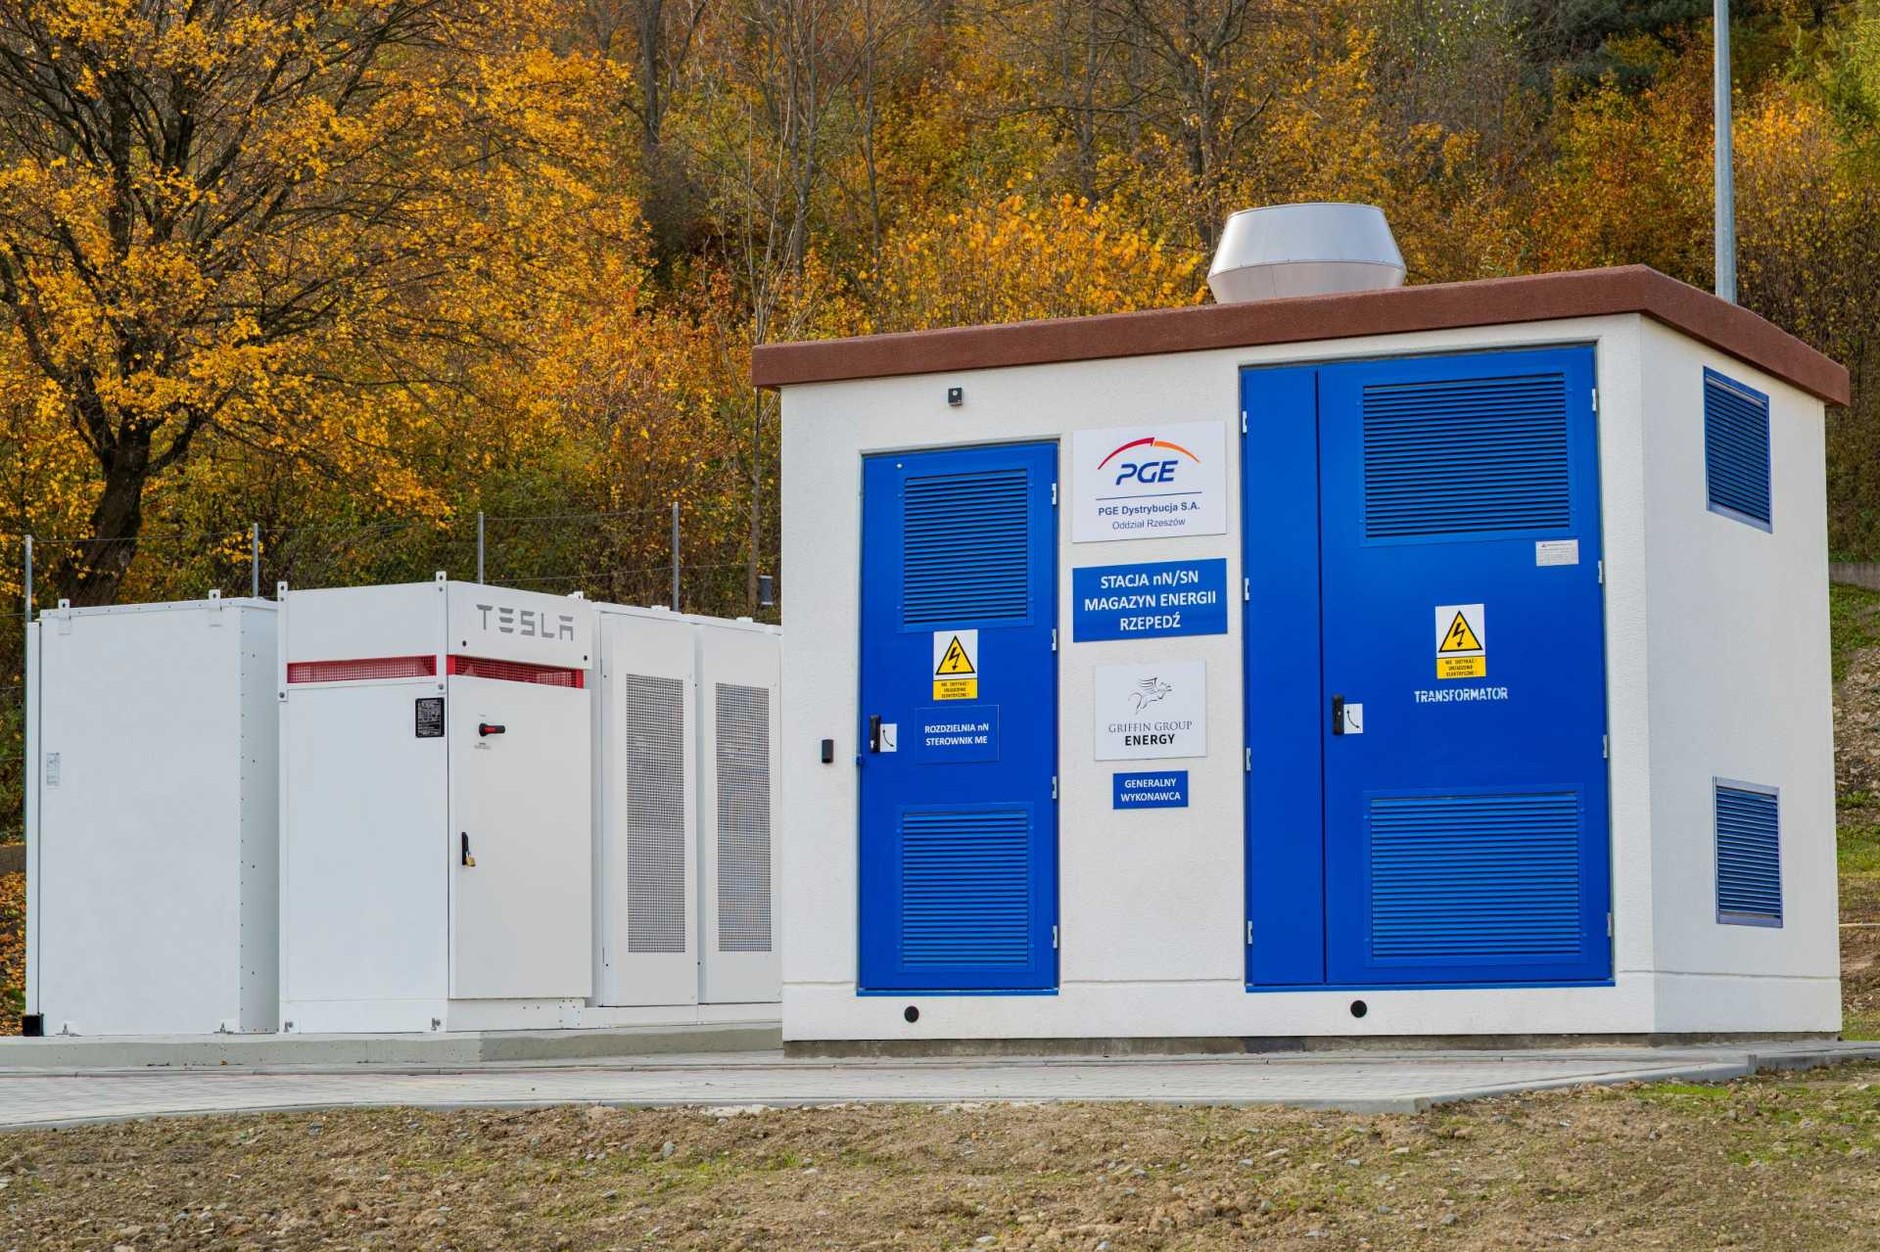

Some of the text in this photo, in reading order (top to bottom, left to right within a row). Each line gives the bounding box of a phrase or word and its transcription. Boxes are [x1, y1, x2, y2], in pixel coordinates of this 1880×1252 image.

[1116, 460, 1178, 485] PGE
[1098, 501, 1201, 516] PGE Dystrybucja S.A.
[1112, 517, 1186, 530] Oddział Rzeszów
[1100, 570, 1199, 589] STACJA nN/SN
[1084, 591, 1217, 611] MAGAZYN ENERGII
[476, 604, 574, 641] TESLA
[1120, 612, 1180, 631] RZEPEDŹ
[1414, 687, 1508, 703] TRANSFORMATOR
[924, 723, 989, 734] ROZDZIELNIA nN
[1108, 721, 1192, 733] GRIFFIN GROUP
[925, 736, 988, 746] STEROWNIK ME
[1125, 733, 1176, 746] ENERGY
[1125, 778, 1177, 789] GENERALNY
[1120, 791, 1181, 802] WYKONAWCA
